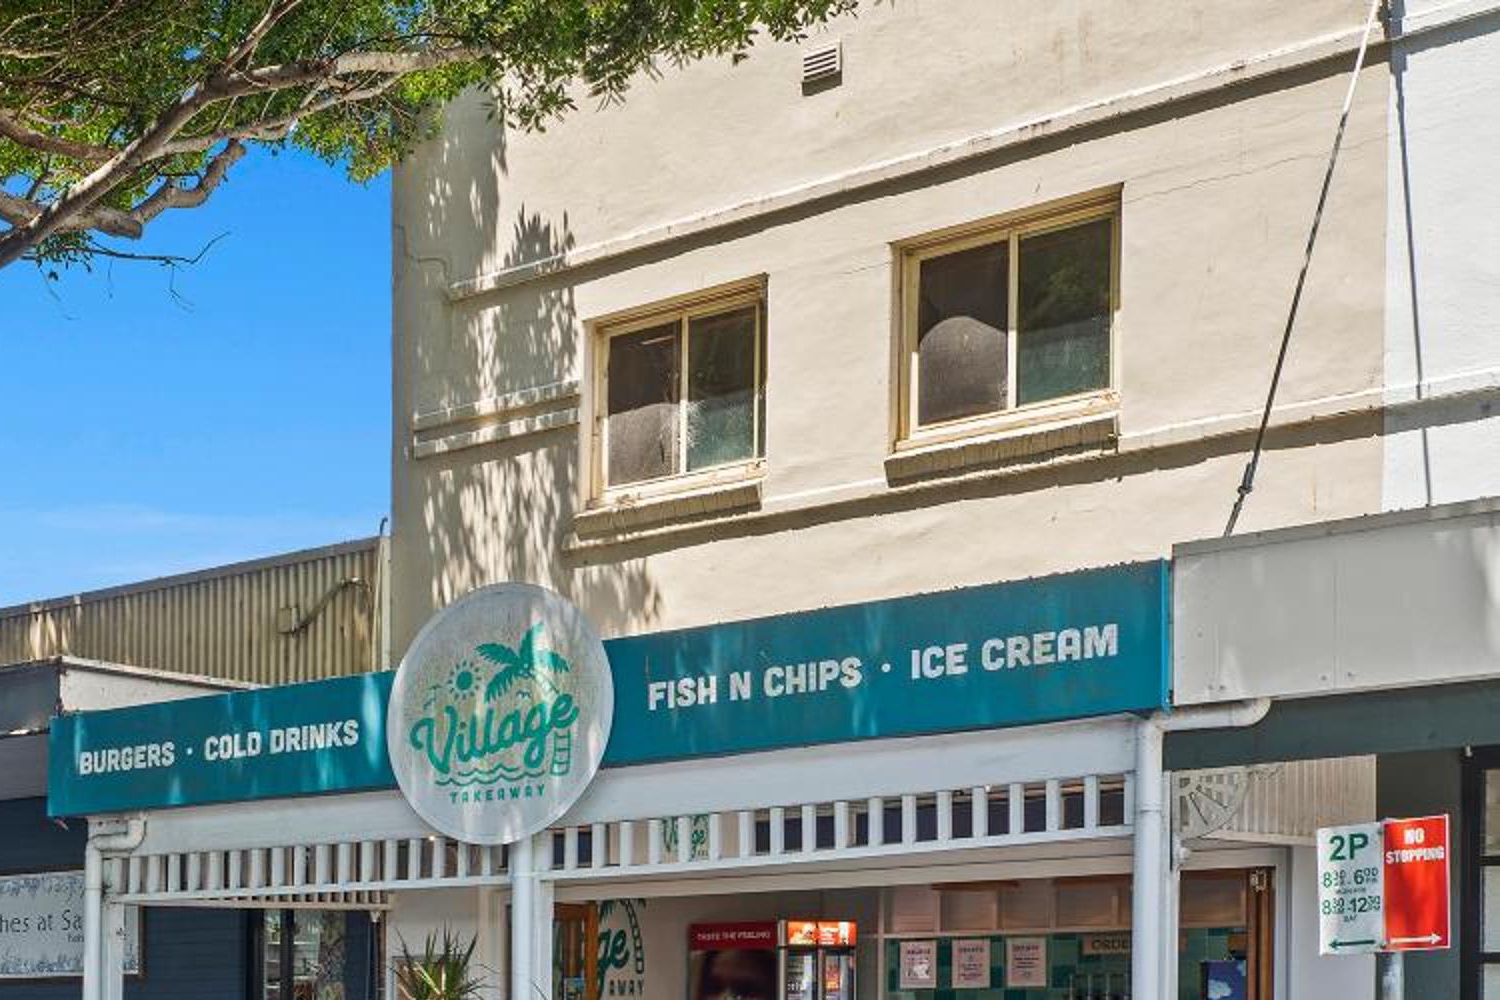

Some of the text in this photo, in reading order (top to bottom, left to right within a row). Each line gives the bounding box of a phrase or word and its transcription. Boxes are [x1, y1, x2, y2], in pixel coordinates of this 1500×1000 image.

[648, 623, 1118, 711] FISH N CHIPS ICE CREAM
[79, 719, 359, 775] BURGERS COLD DRINKS
[409, 693, 580, 774] Village
[450, 783, 546, 803] TAKEAWAY
[1329, 832, 1369, 861] 2P
[1404, 828, 1425, 844] NO
[37, 912, 54, 931] at
[61, 909, 84, 931] Sa
